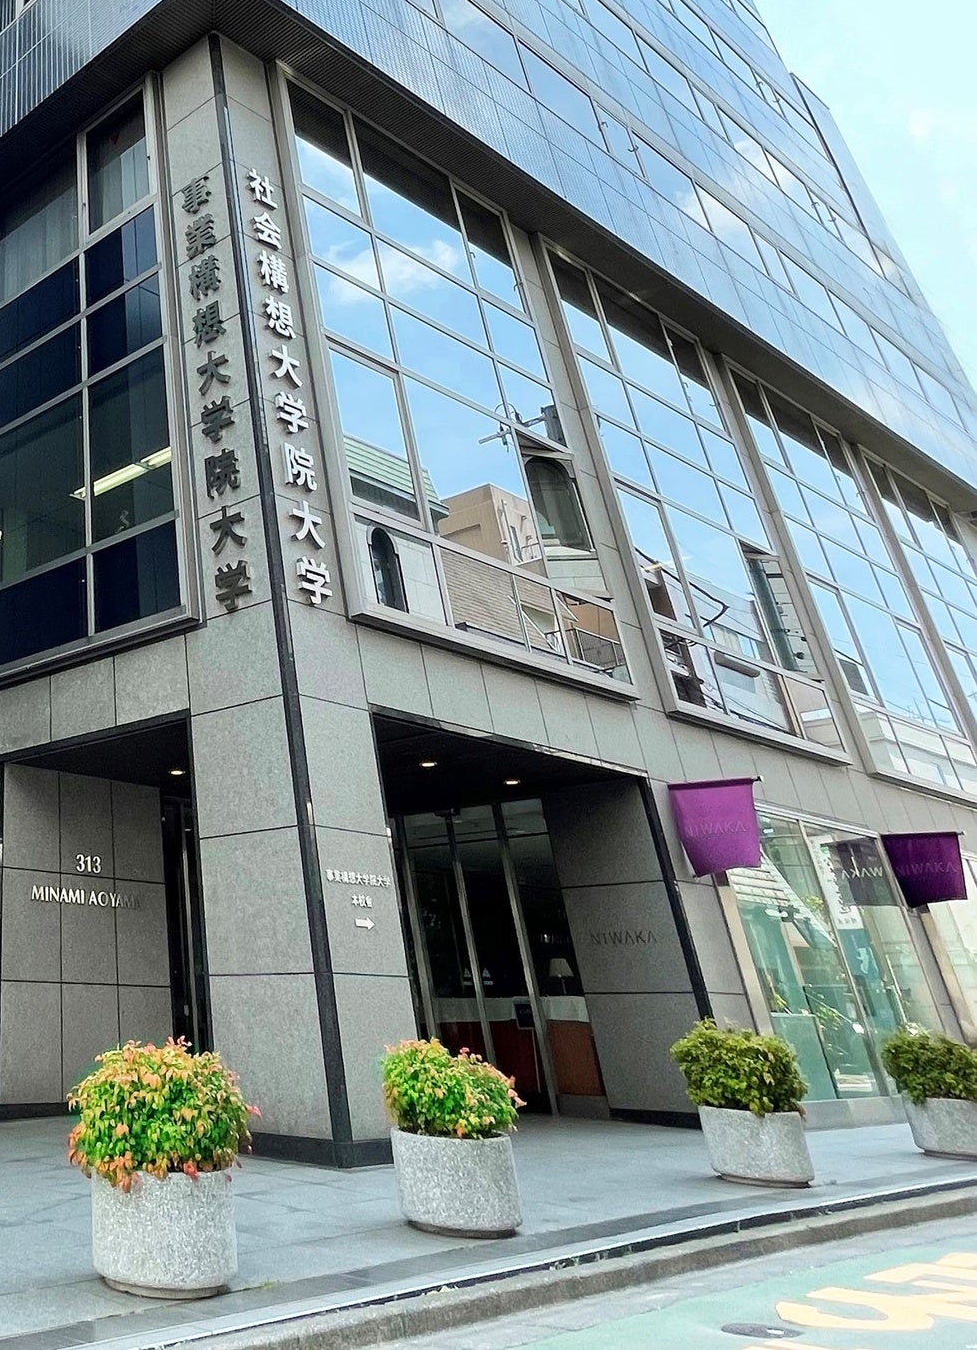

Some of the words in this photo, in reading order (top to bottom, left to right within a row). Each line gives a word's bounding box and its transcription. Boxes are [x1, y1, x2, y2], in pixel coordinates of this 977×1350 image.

[180, 174, 253, 611] 事業構想大学院大学
[246, 167, 333, 607] 社会構想大学院大学
[684, 820, 747, 839] NIWAKA
[76, 853, 102, 874] 313
[894, 861, 957, 877] NIWAKA
[31, 885, 85, 906] MINAMI
[590, 929, 659, 946] NIWAKA
